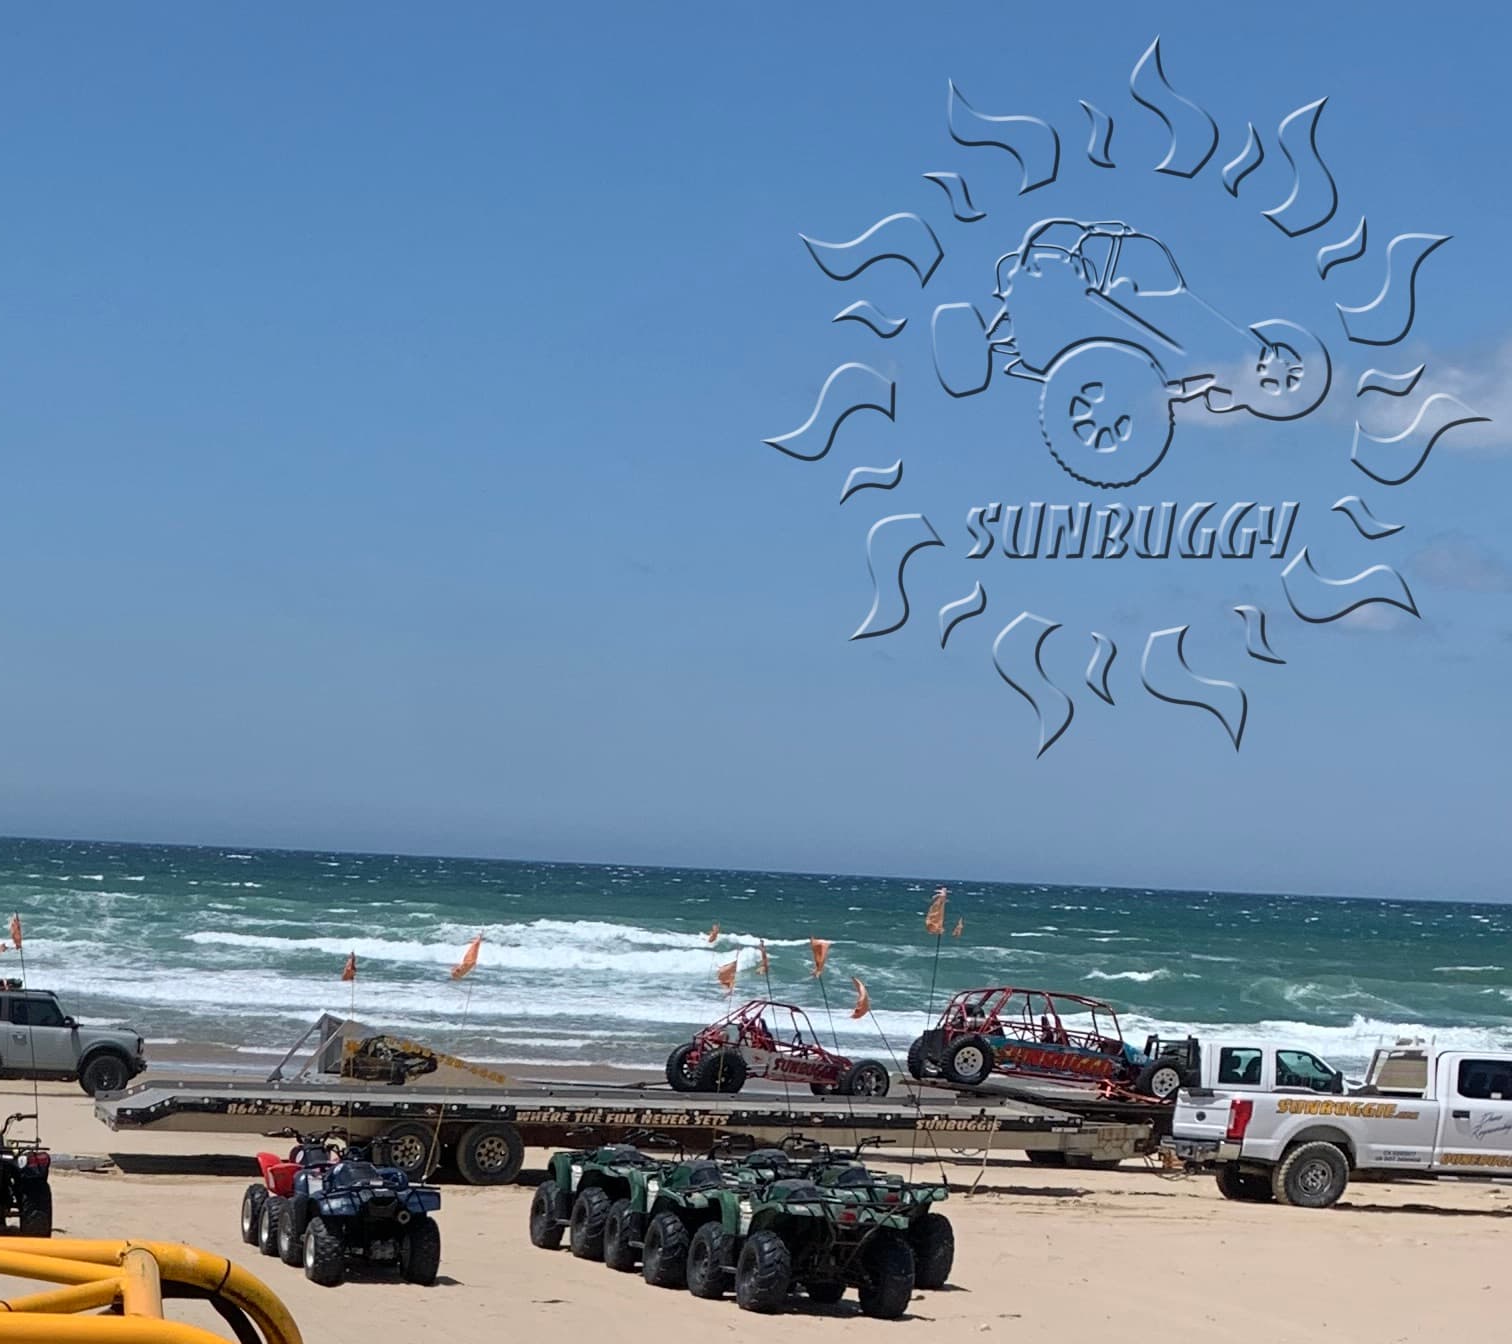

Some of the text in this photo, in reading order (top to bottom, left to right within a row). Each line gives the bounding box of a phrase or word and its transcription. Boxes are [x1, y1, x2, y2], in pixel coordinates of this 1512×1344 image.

[516, 1110, 729, 1126] WHERE THE FUN NEVER SETS
[916, 1119, 1002, 1131] SUNBUGGIE
